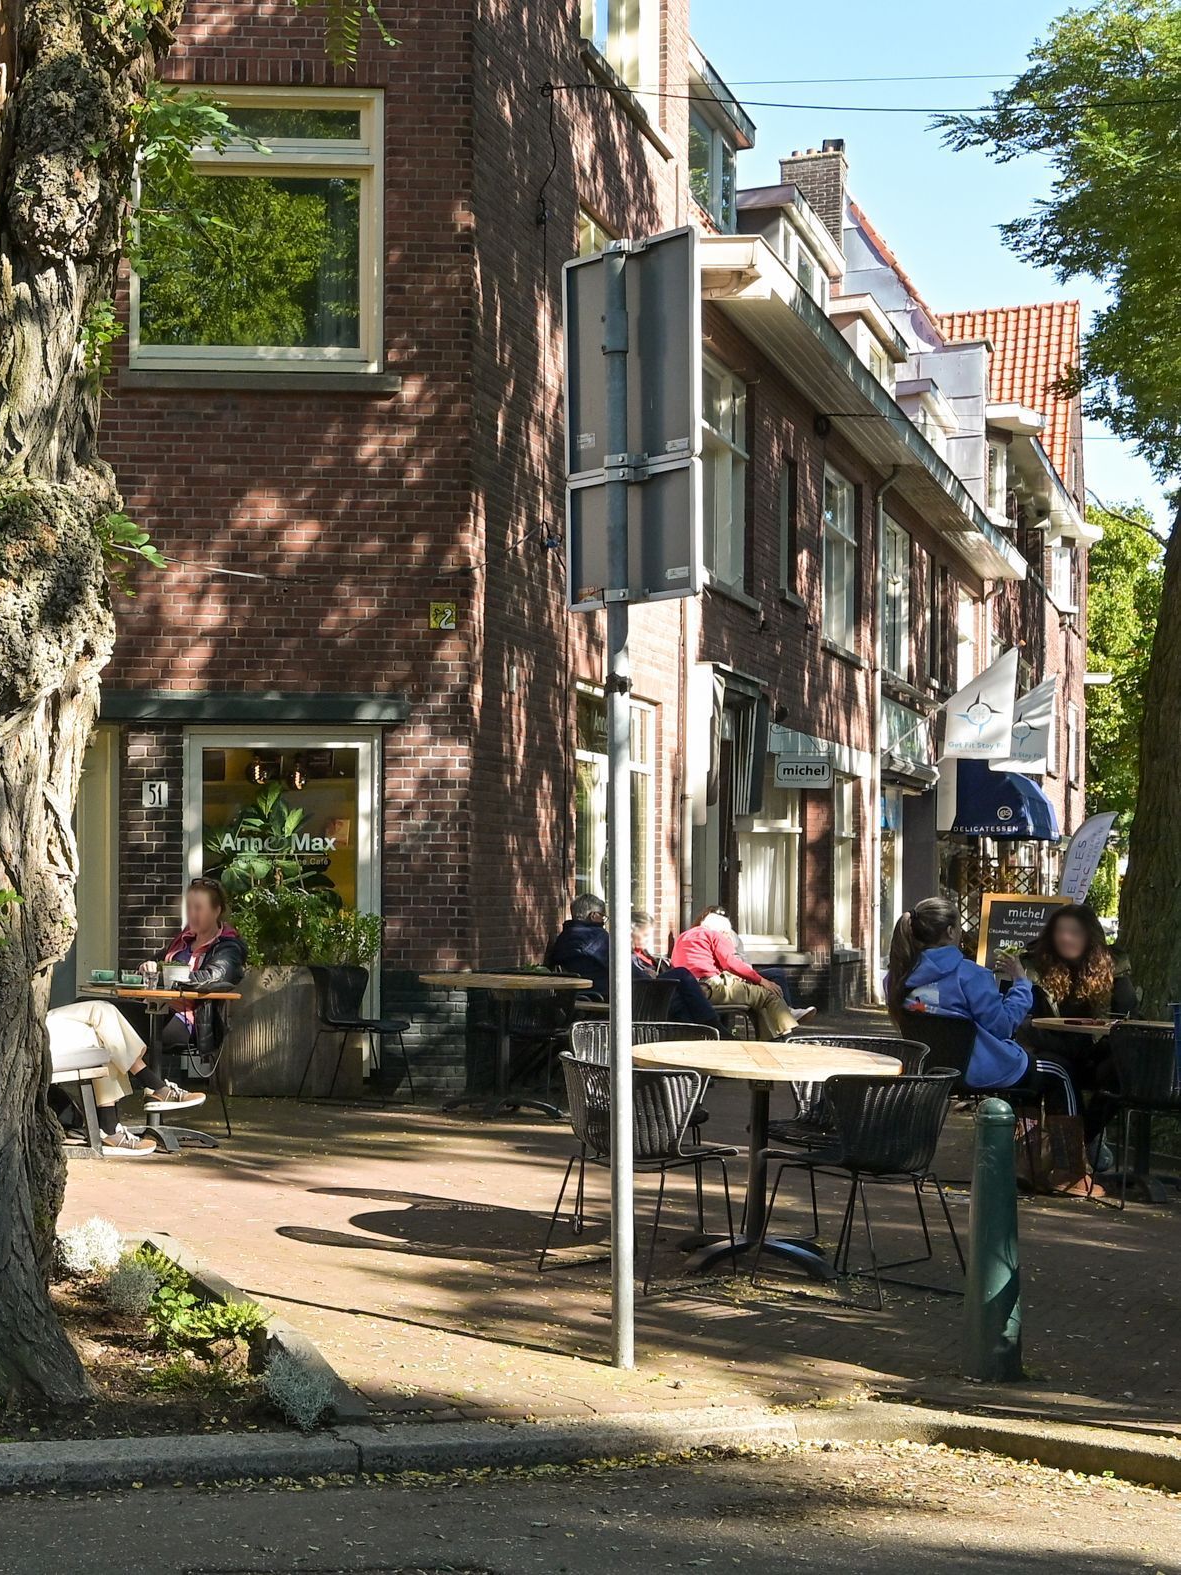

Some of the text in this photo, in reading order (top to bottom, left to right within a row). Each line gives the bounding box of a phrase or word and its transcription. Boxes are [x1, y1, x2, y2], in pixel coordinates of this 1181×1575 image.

[782, 765, 825, 776] michel
[149, 783, 162, 806] 51
[953, 825, 1019, 833] DELICATESSEN
[1008, 907, 1045, 920] michel
